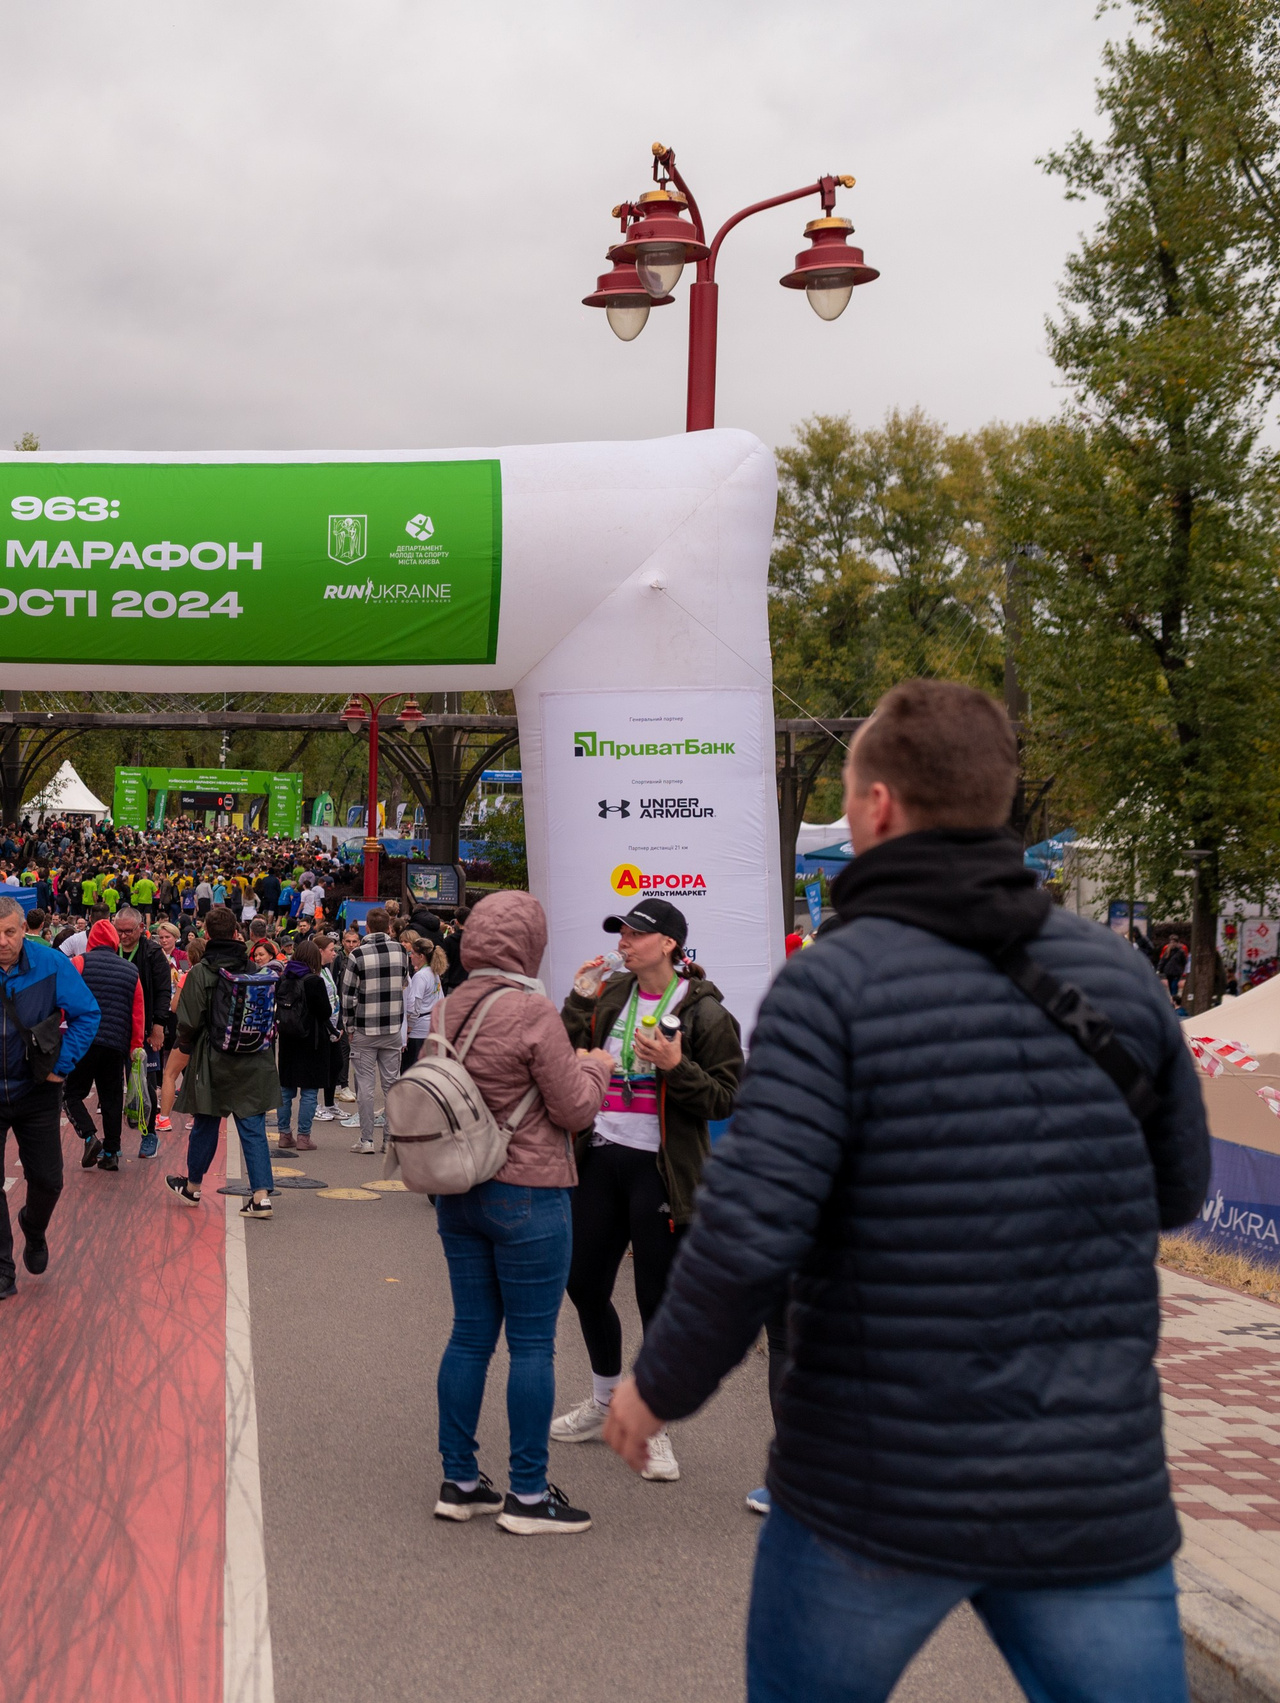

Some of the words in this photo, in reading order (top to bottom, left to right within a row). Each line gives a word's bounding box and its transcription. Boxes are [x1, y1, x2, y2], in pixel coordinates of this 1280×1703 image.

[11, 496, 120, 522] 963:
[6, 539, 263, 571] МАРАФОН
[111, 590, 243, 619] 2024
[599, 739, 736, 760] ПриватБанк
[639, 798, 699, 808] UNDER
[639, 808, 714, 819] ARMOUR
